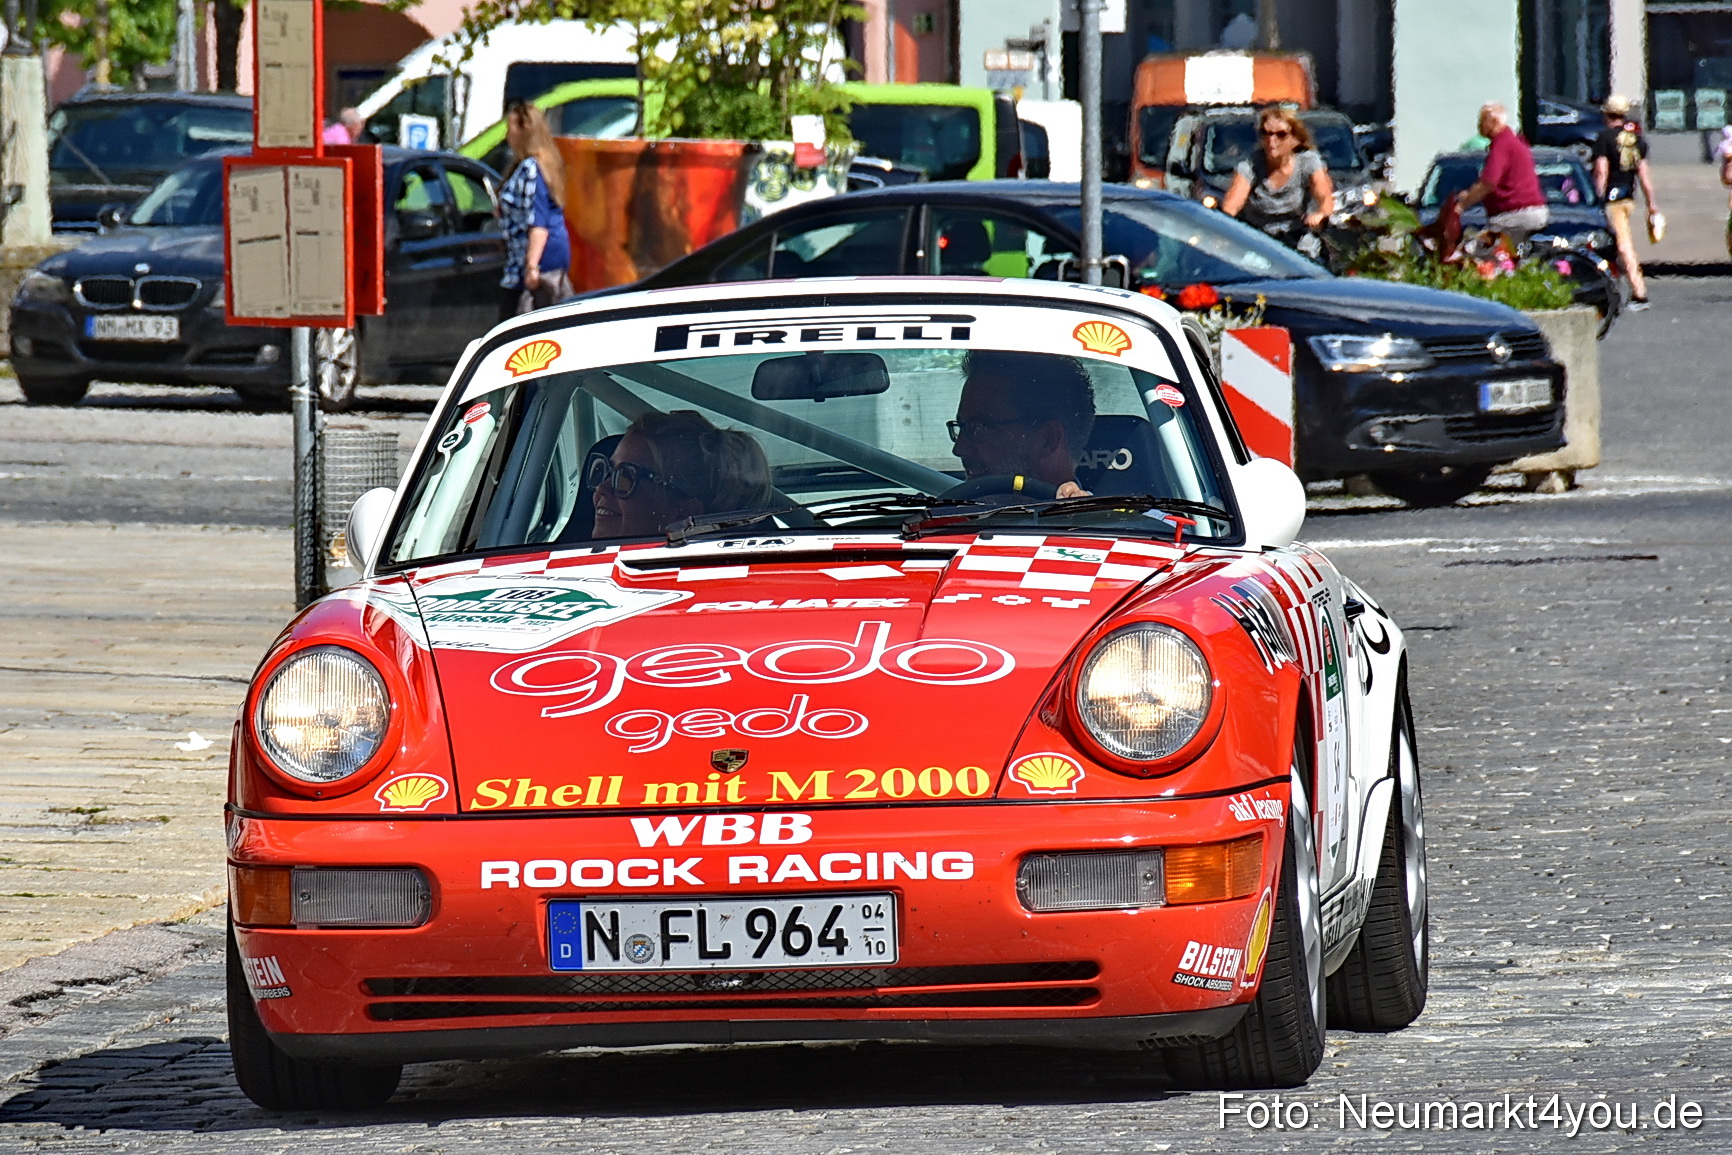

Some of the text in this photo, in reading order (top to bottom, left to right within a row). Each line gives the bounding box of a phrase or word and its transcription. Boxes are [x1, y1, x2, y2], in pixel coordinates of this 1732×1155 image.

[654, 314, 976, 352] PIRELLI
[722, 538, 787, 549] FIA
[497, 588, 552, 600] 108
[685, 597, 911, 613] FOLIATEC
[490, 621, 1016, 718] gedo
[604, 694, 869, 753] gedo
[469, 776, 623, 811] Shell
[643, 773, 747, 805] mit
[630, 813, 813, 848] WBB
[480, 851, 974, 889] ROOCK RACING
[862, 904, 885, 919] 04
[586, 911, 621, 961] N
[660, 909, 732, 960] FL
[745, 904, 849, 958] 964
[865, 939, 887, 955] 10
[560, 943, 572, 958] D
[1178, 940, 1243, 978] BILSTEIN
[1174, 973, 1207, 988] SHOCK
